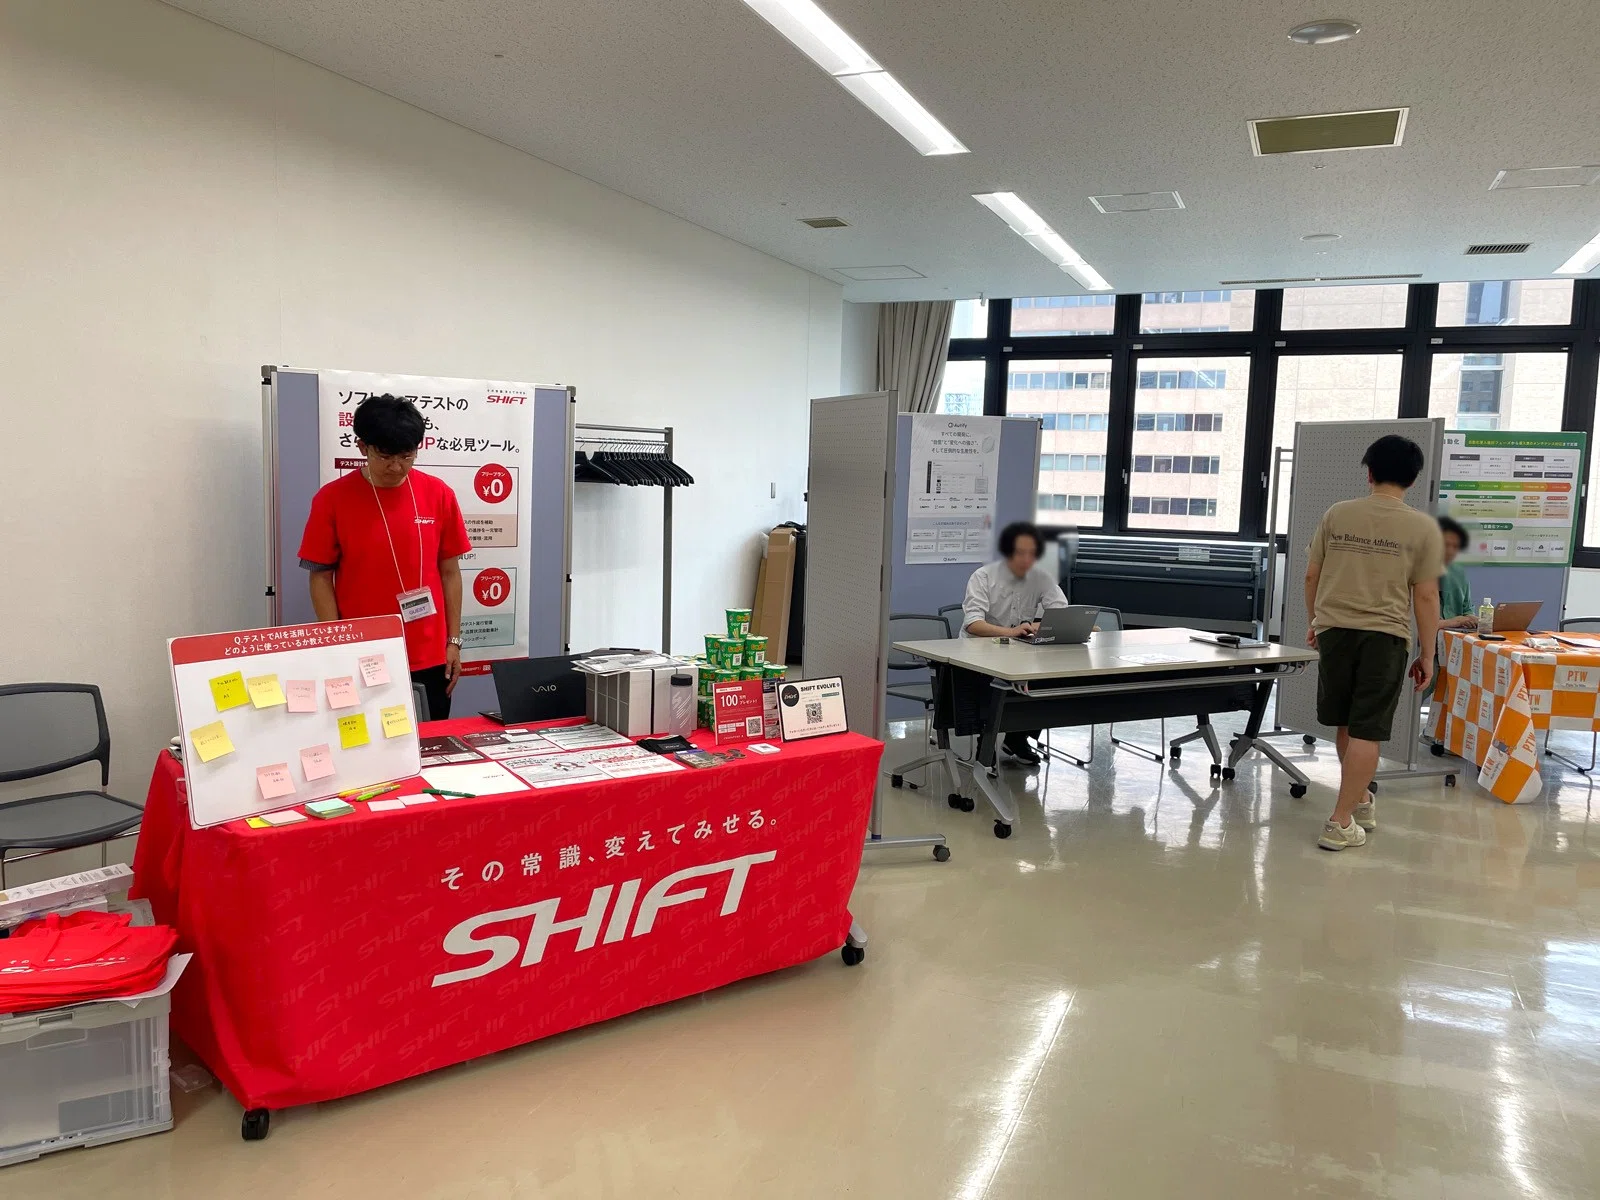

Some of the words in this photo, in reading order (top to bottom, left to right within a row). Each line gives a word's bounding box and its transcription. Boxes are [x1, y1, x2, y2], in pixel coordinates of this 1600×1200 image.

[486, 394, 528, 405] SHIFT
[482, 478, 504, 497] ¥0
[1344, 533, 1372, 545] Balance
[481, 582, 502, 600] ¥0
[1567, 670, 1588, 682] PTW
[531, 684, 557, 693] VAIO
[816, 682, 836, 690] EVOLVE
[720, 694, 738, 708] 100
[440, 808, 778, 892] その常識、変えてみせる。
[431, 850, 778, 988] SHIFT
